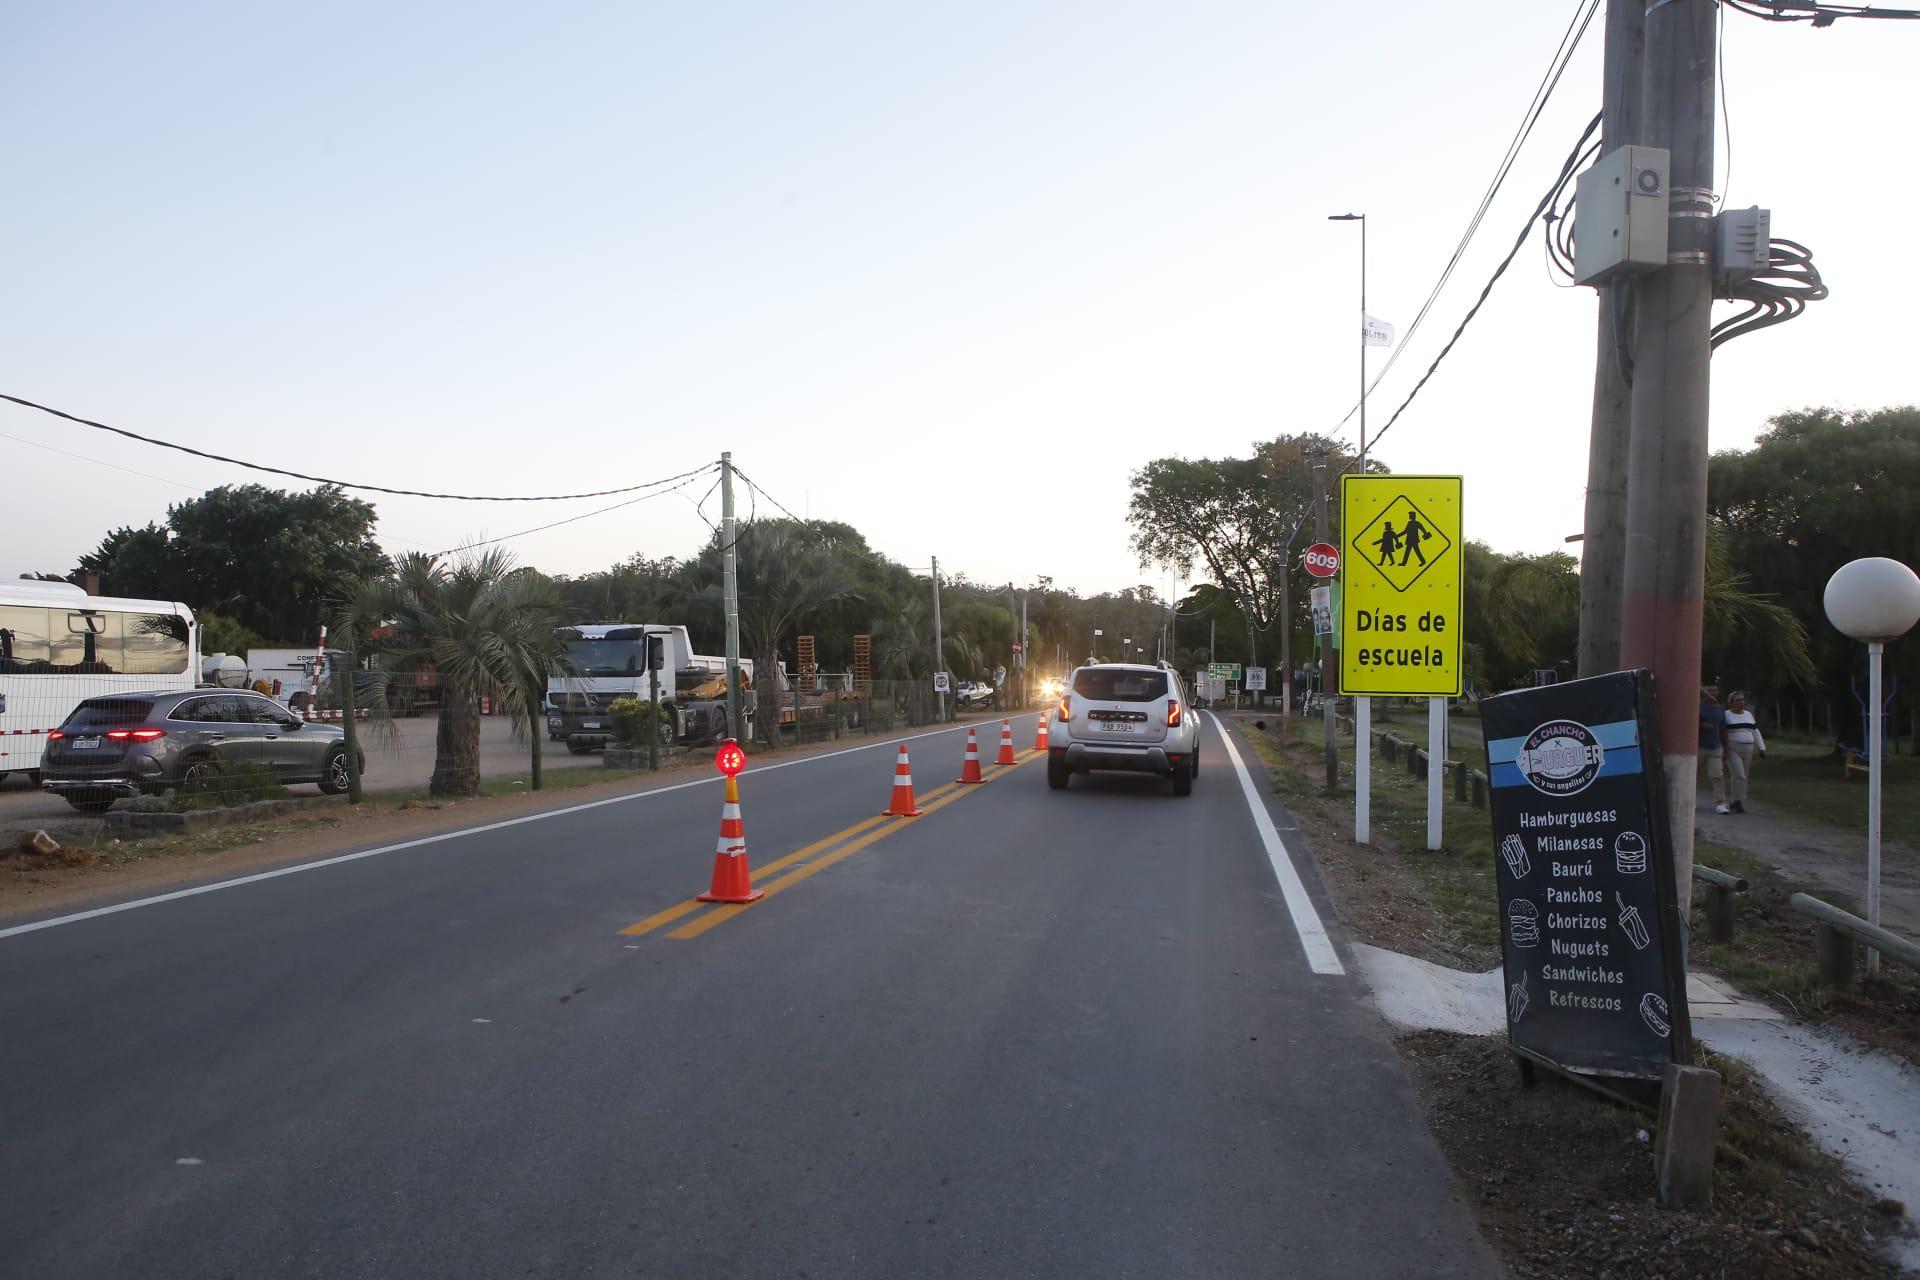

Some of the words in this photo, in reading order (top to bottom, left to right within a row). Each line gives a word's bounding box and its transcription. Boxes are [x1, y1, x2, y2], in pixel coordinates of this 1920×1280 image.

[1306, 552, 1338, 569] 609
[1357, 608, 1407, 632] Días
[1418, 611, 1446, 632] de
[1358, 645, 1443, 667] escuela
[1530, 736, 1541, 748] EL
[1540, 725, 1586, 740] CHANCHO
[1520, 810, 1617, 828] Hamburguesas
[1537, 836, 1604, 852] Milanesas
[1552, 860, 1593, 877] Baurú
[1546, 886, 1602, 903] Panchos
[1547, 912, 1607, 929] Chorizos
[1551, 939, 1609, 958] Nuguets
[1542, 964, 1624, 984] Sandwiches
[1549, 990, 1621, 1010] Refrescos
